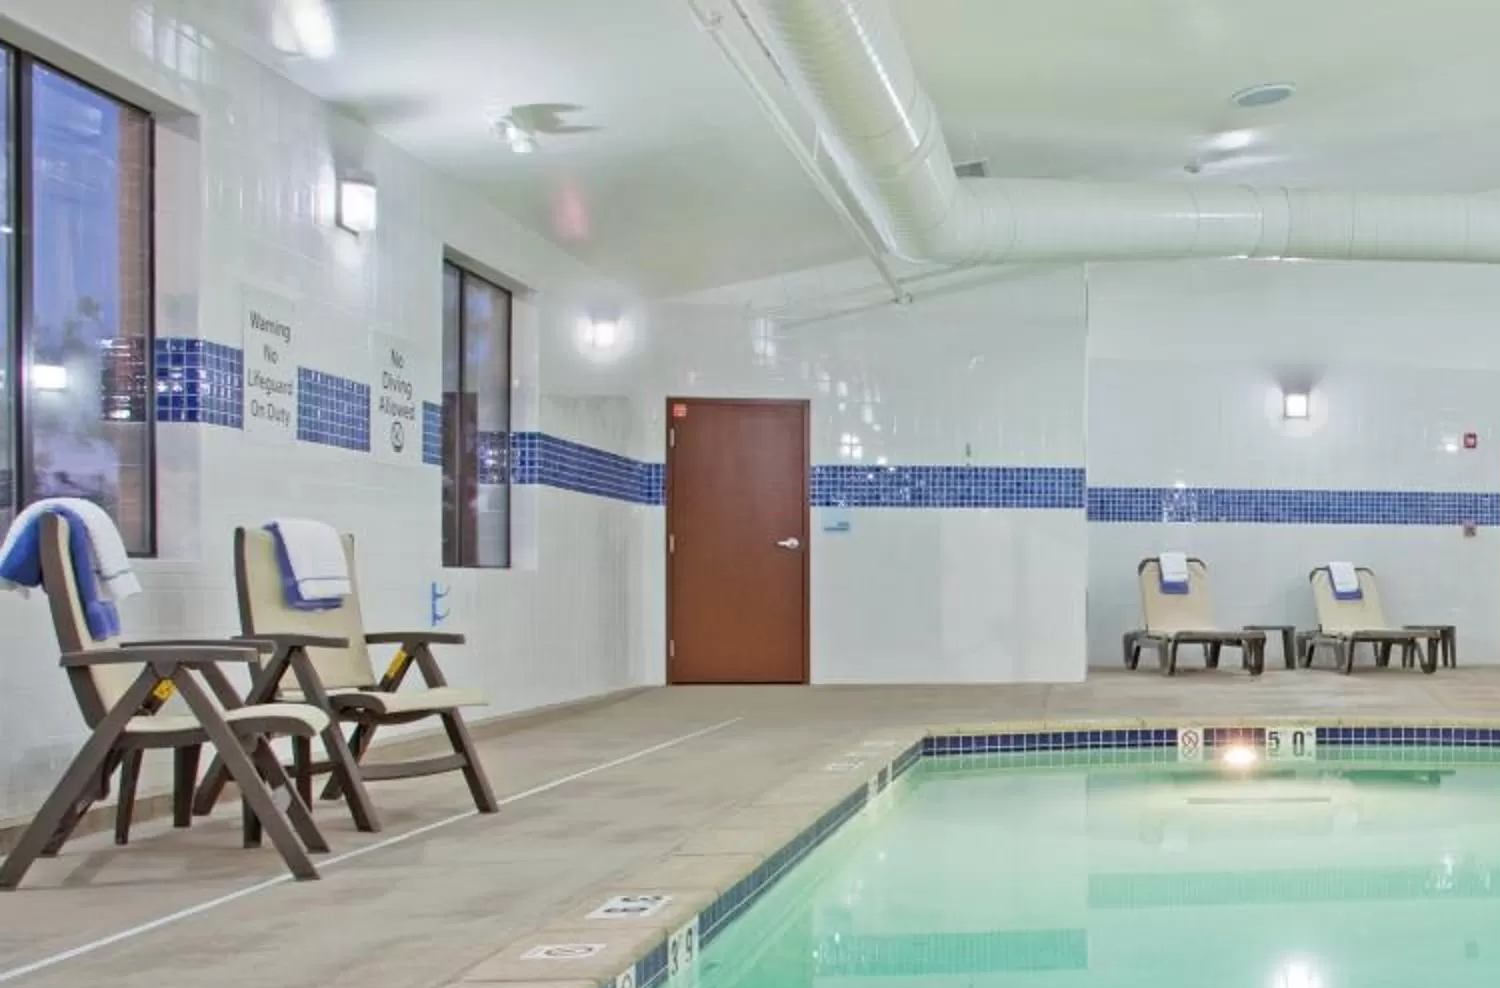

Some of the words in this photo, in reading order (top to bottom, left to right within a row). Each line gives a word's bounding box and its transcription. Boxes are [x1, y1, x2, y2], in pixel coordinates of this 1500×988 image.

[249, 311, 291, 343] Warning
[263, 344, 279, 364] No
[391, 349, 405, 368] No
[247, 367, 293, 396] Lifeguard
[383, 371, 413, 401] Diving
[250, 399, 266, 418] On
[266, 403, 291, 427] Duty
[379, 396, 415, 421] Allowed
